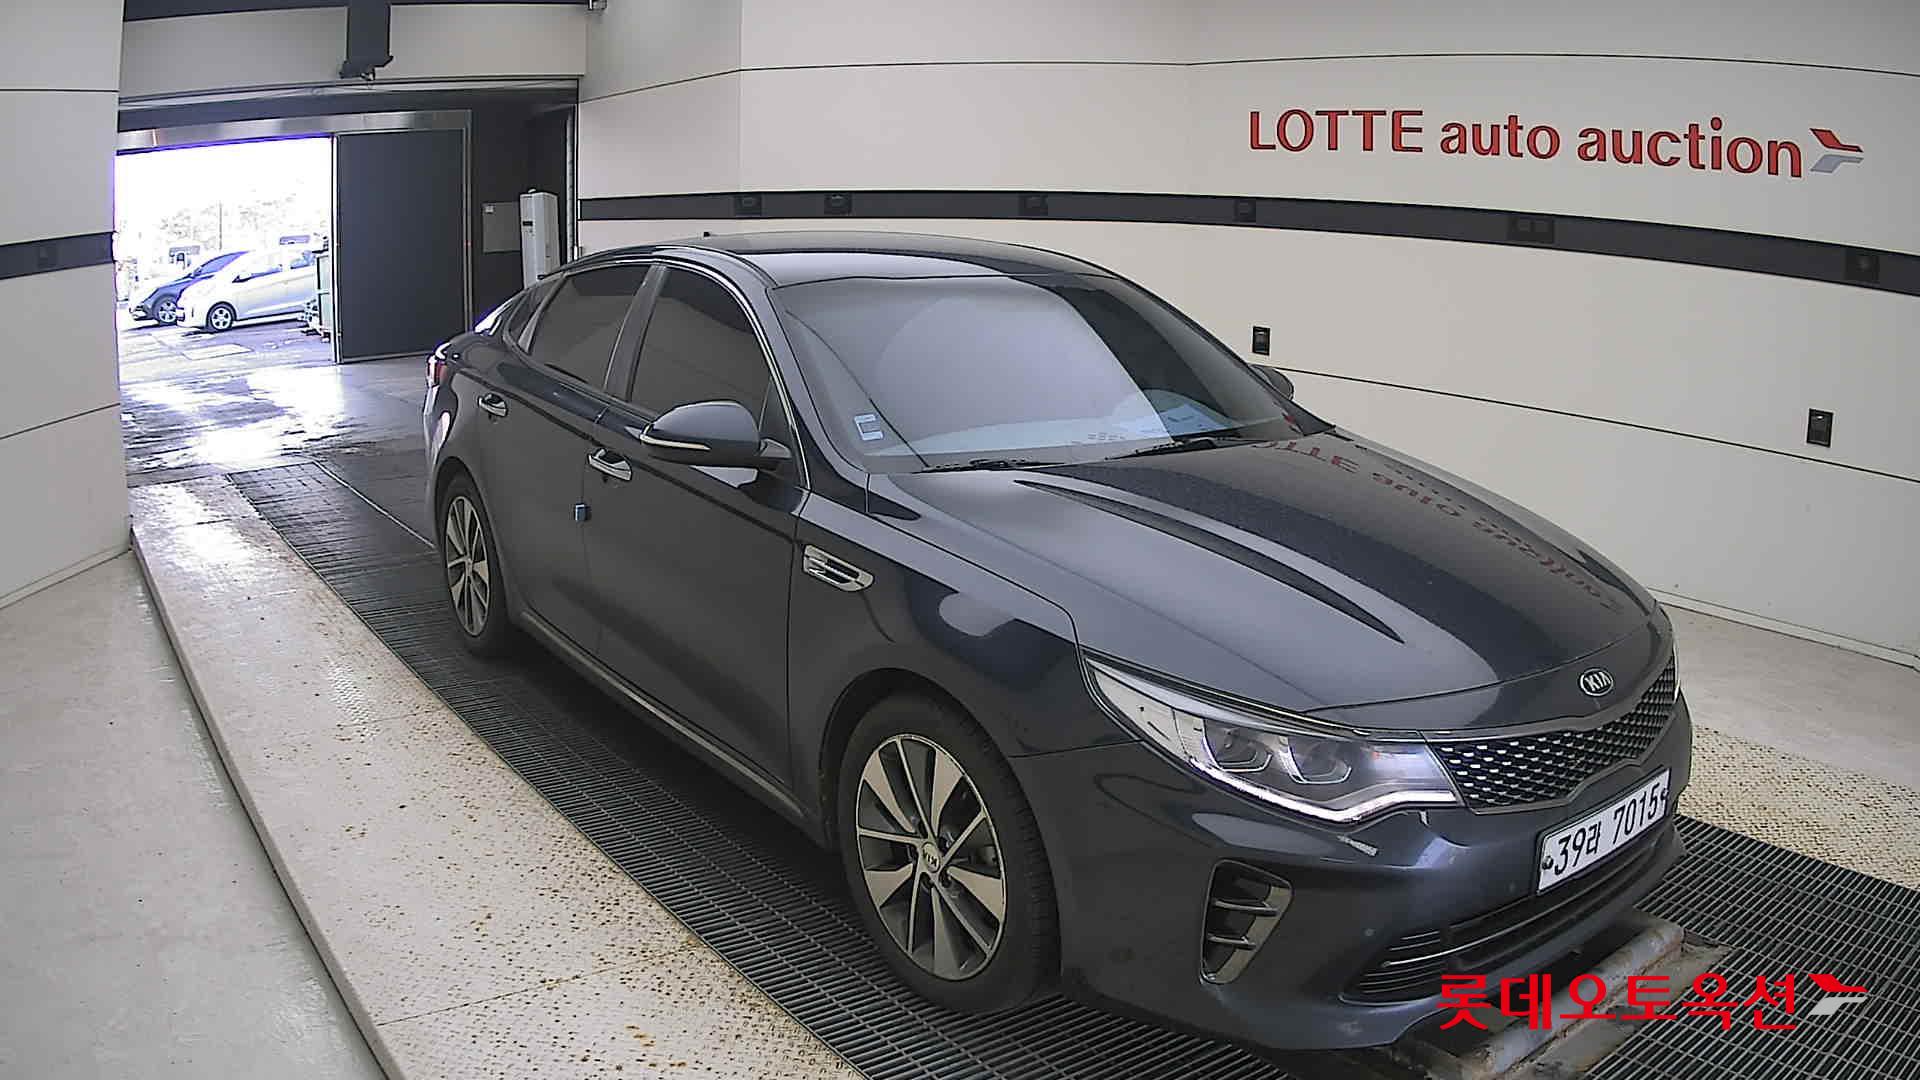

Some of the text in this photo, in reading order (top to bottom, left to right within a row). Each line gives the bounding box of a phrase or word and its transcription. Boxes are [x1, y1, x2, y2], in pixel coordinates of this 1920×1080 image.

[1249, 110, 1803, 178] LOTTE auto auction
[1613, 783, 1660, 845] 7015
